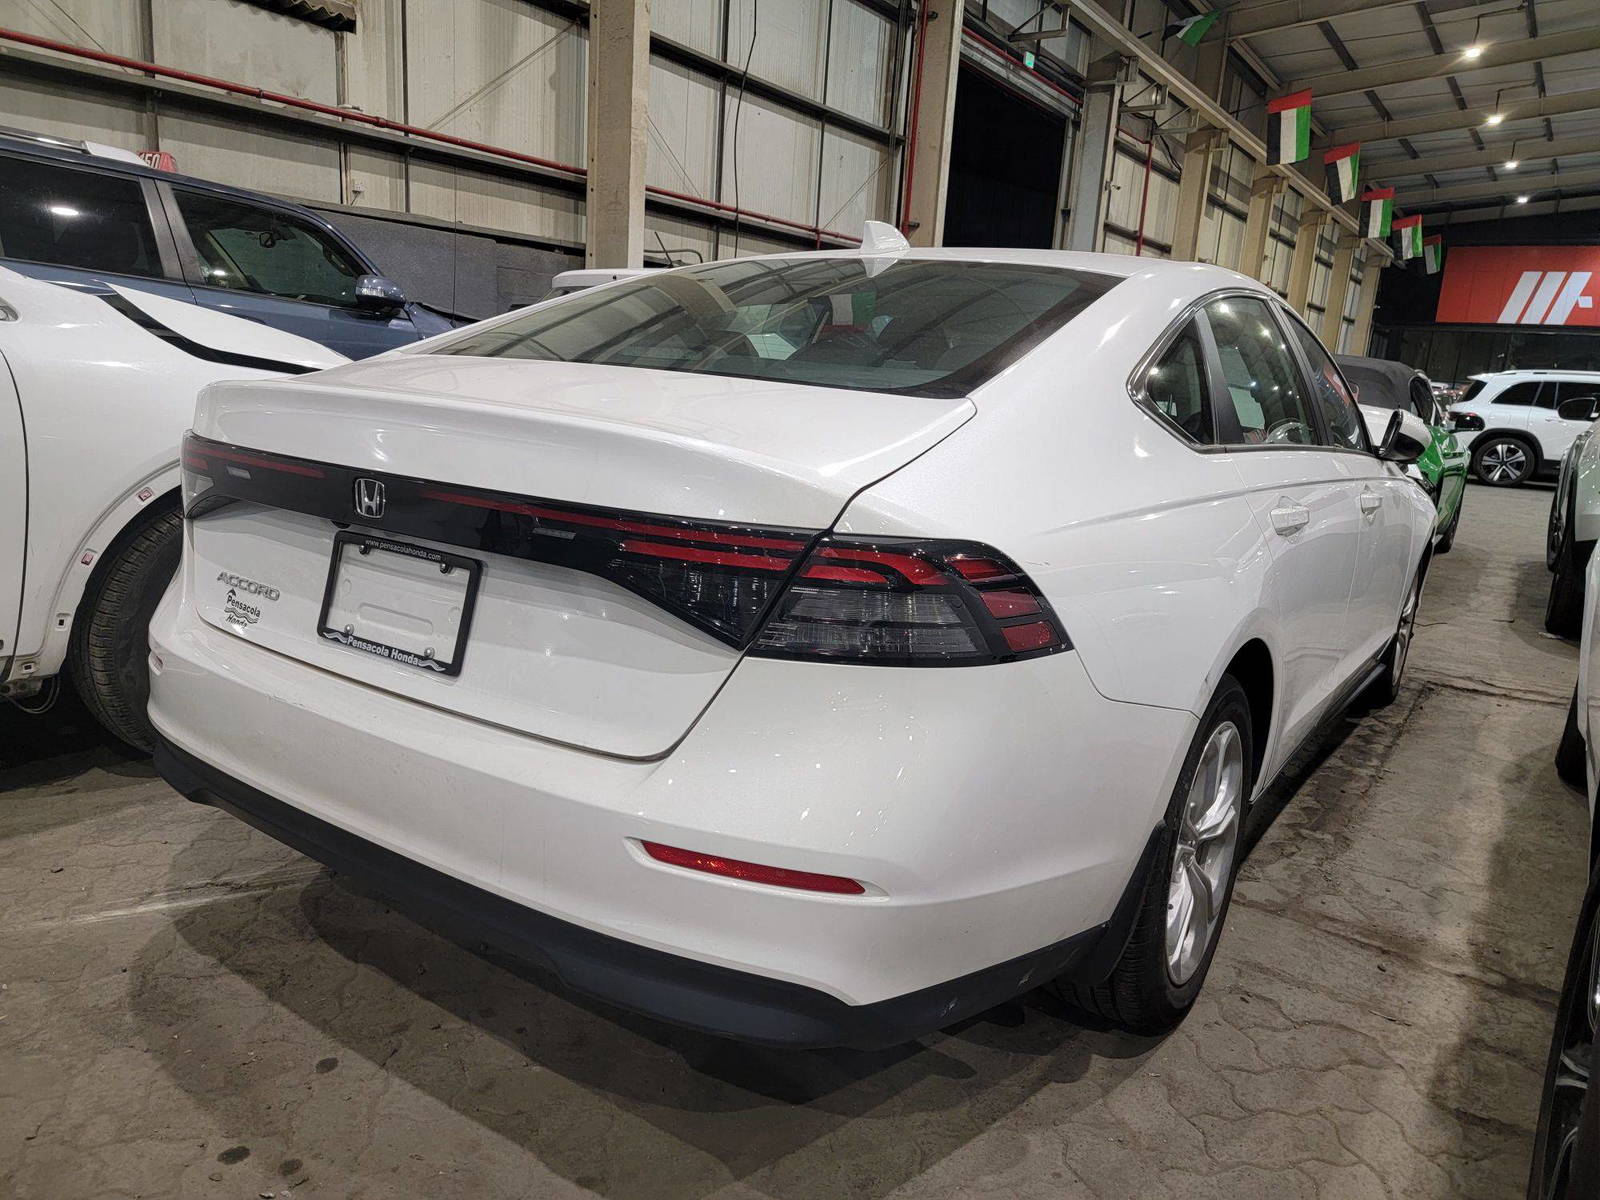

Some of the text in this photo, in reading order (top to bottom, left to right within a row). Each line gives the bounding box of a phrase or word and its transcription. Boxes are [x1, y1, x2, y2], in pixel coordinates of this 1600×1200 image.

[365, 539, 442, 561] www.pensacolahonda.com
[216, 571, 281, 602] ACCORD
[226, 594, 262, 617] Pensacola
[225, 614, 248, 629] Honda
[346, 635, 422, 666] Pensacola Honda
